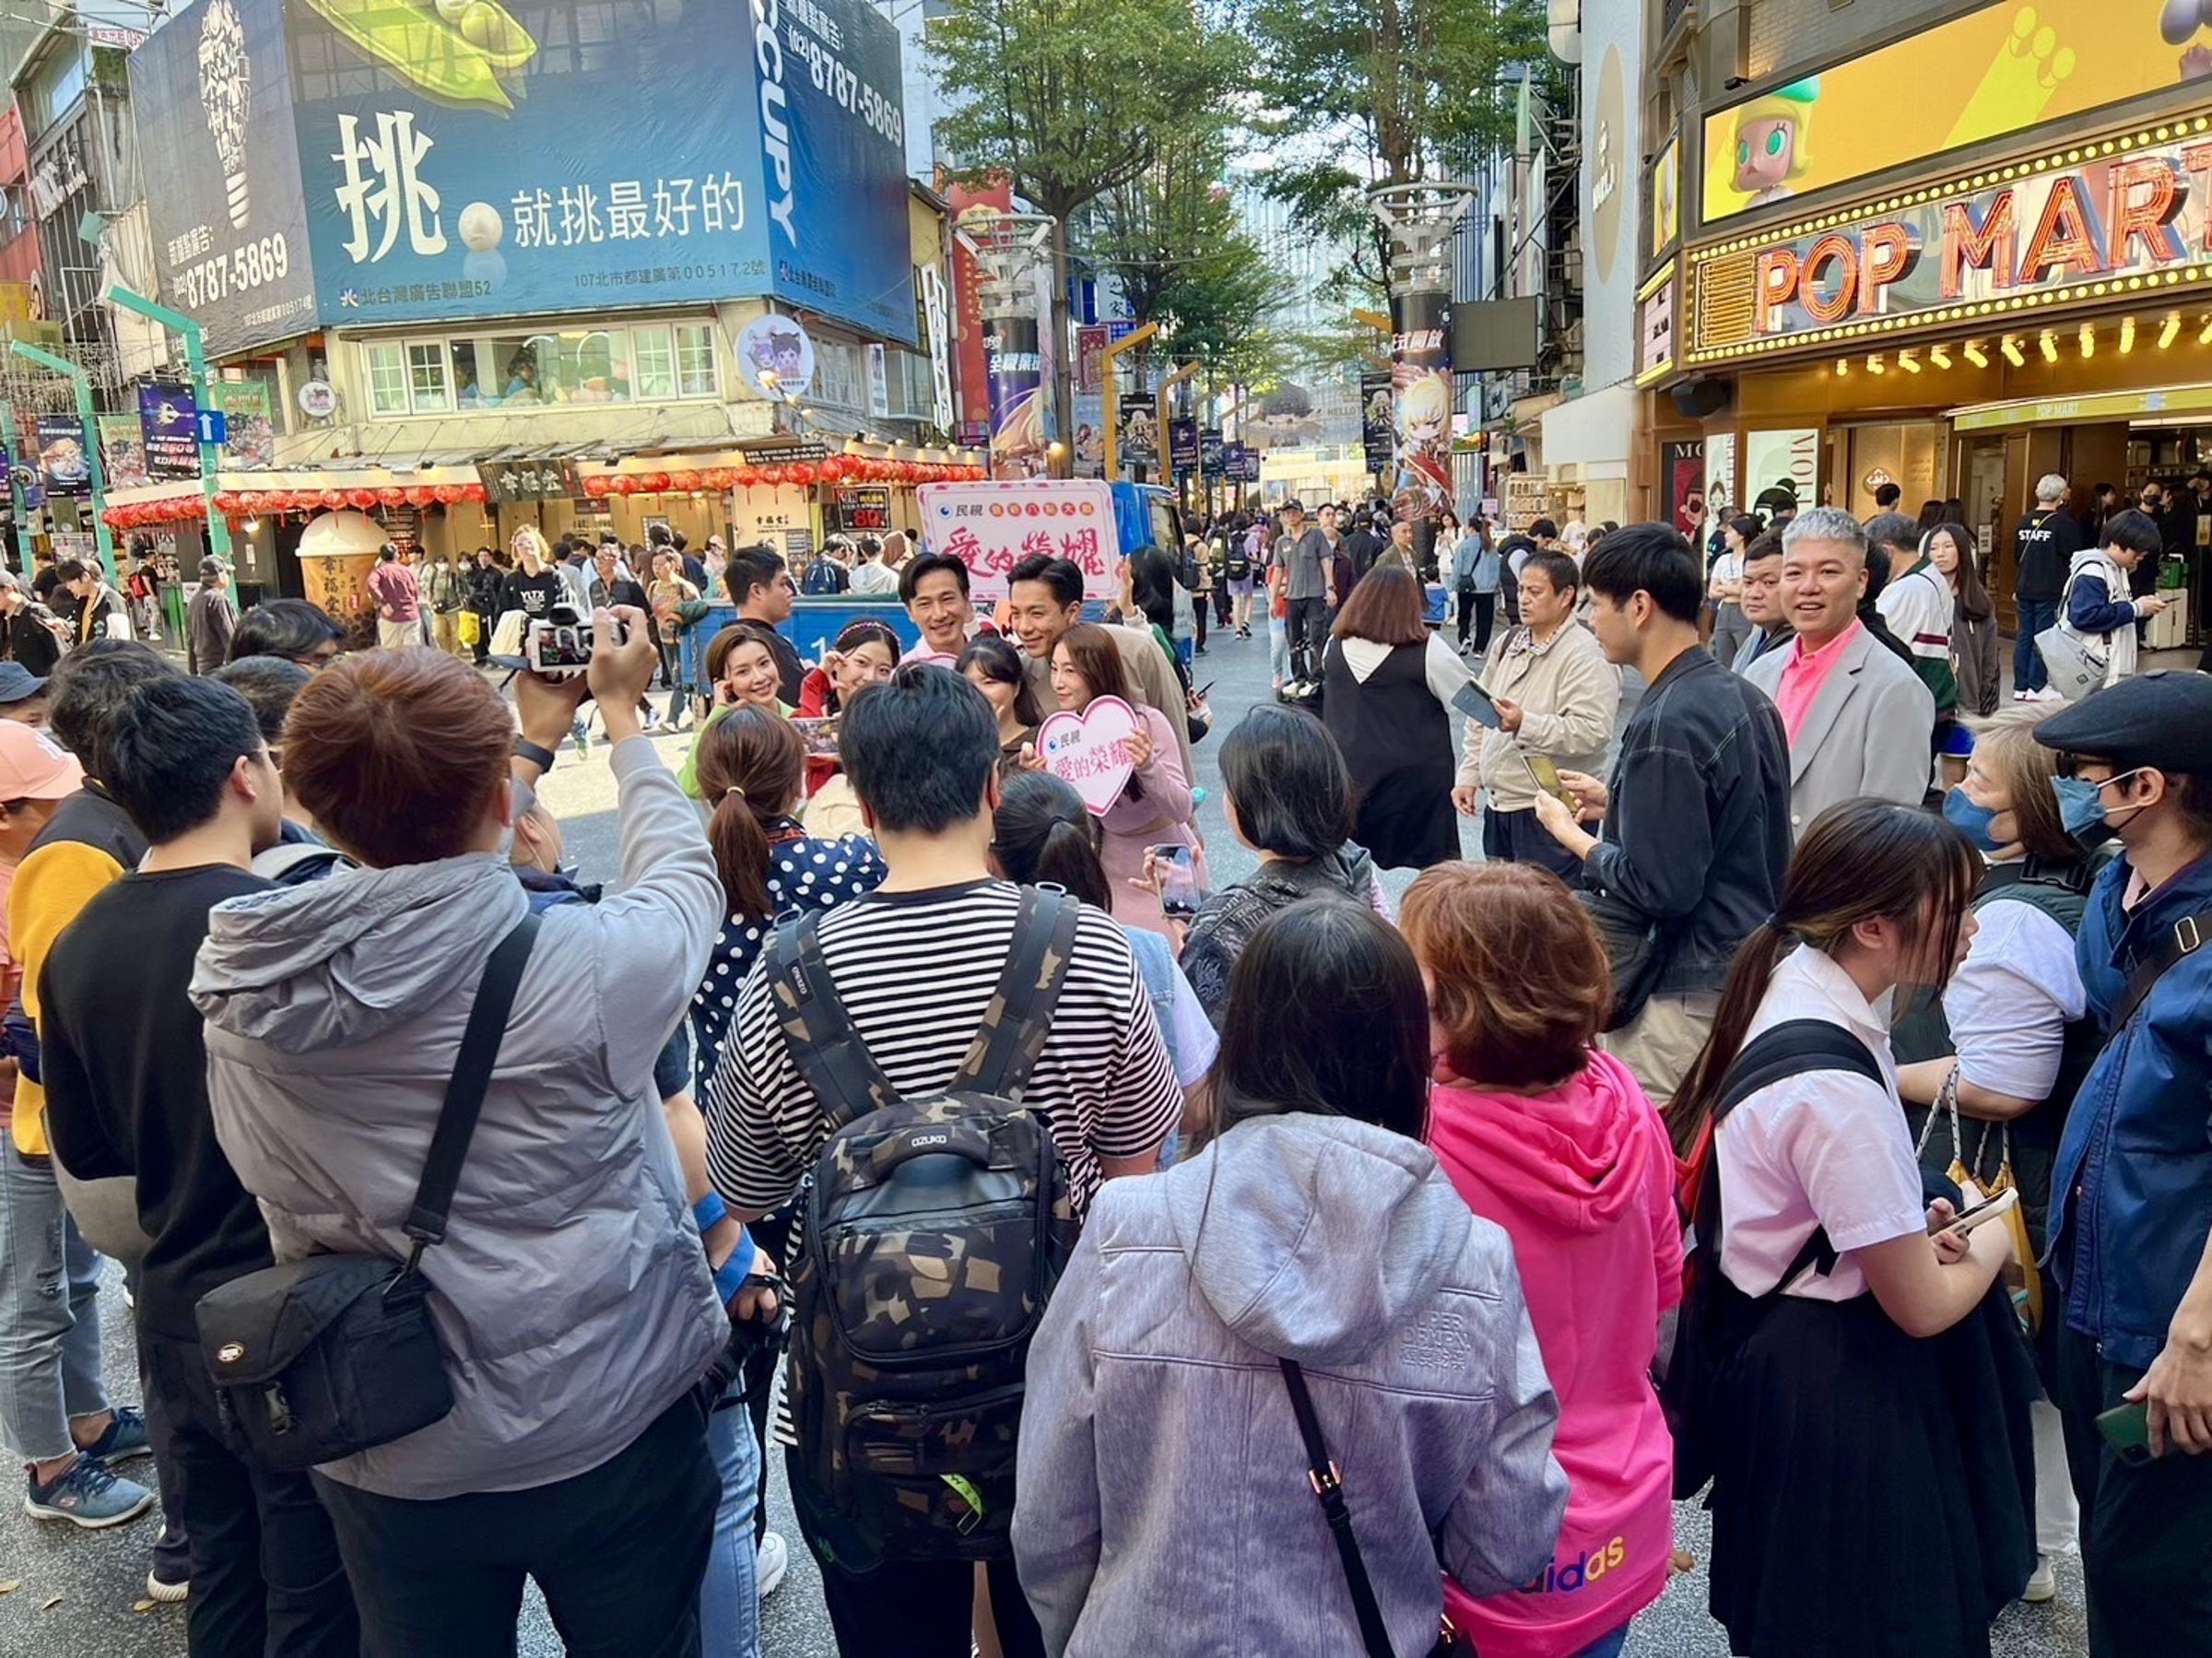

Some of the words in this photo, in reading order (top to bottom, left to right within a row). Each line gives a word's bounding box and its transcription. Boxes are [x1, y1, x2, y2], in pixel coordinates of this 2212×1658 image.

[789, 23, 903, 148] (02)8787-5869
[331, 110, 448, 264] 挑
[512, 171, 746, 249] 就挑最好的
[1753, 221, 1922, 334] POP
[955, 504, 983, 517] 民視
[2018, 529, 2053, 542] STAFF
[1054, 739, 1131, 782] 愛的榮耀
[1060, 729, 1082, 749] 民視
[1516, 1535, 1625, 1594] idas
